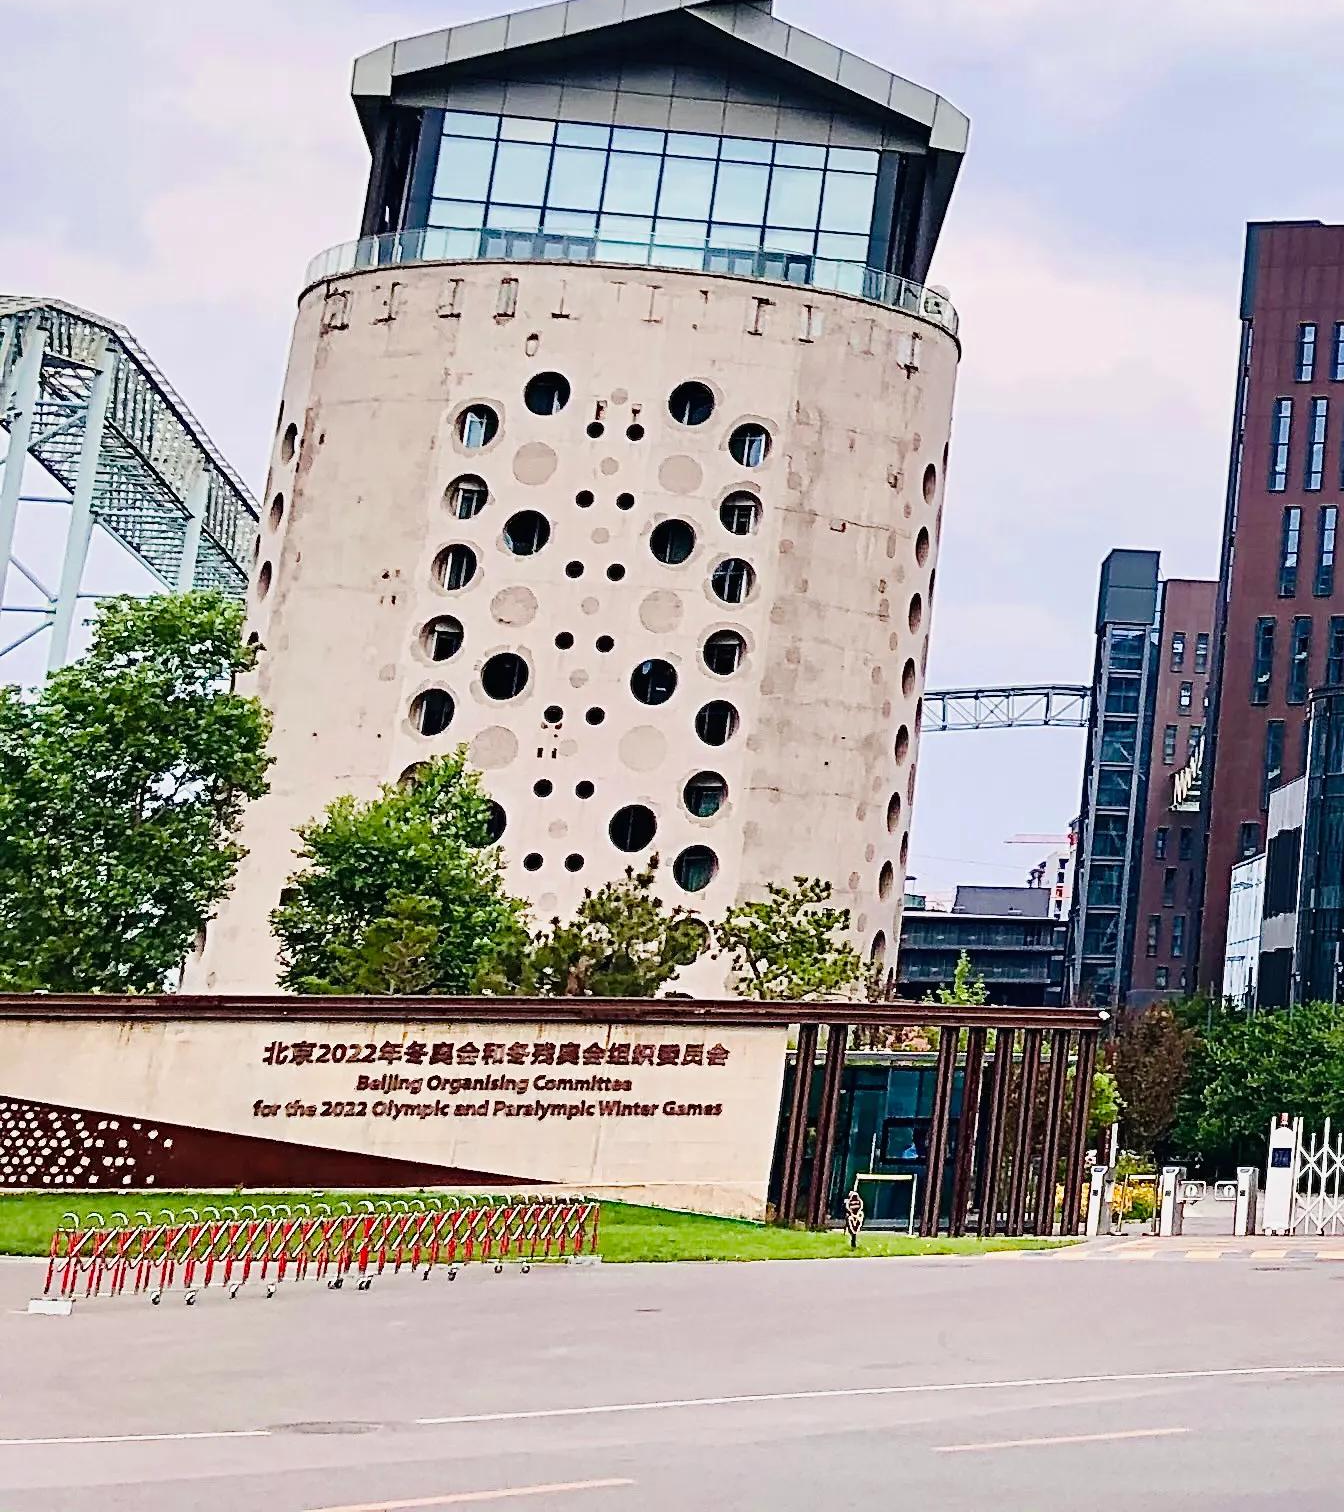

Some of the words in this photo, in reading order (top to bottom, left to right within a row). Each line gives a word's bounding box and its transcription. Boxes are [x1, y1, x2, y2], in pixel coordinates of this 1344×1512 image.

[262, 1040, 731, 1066] 北京2022年冬奥会和冬残奥会组织委员会
[355, 1073, 424, 1094] Beijing
[426, 1073, 529, 1094] Organising
[533, 1074, 633, 1091] Committee
[252, 1099, 281, 1117] for
[285, 1099, 317, 1117] the
[320, 1100, 368, 1117] 2022
[372, 1099, 450, 1120] Olympic
[453, 1099, 489, 1117] and
[493, 1100, 596, 1121] Paralympic
[598, 1100, 660, 1117] Winter
[662, 1100, 723, 1117] Games
